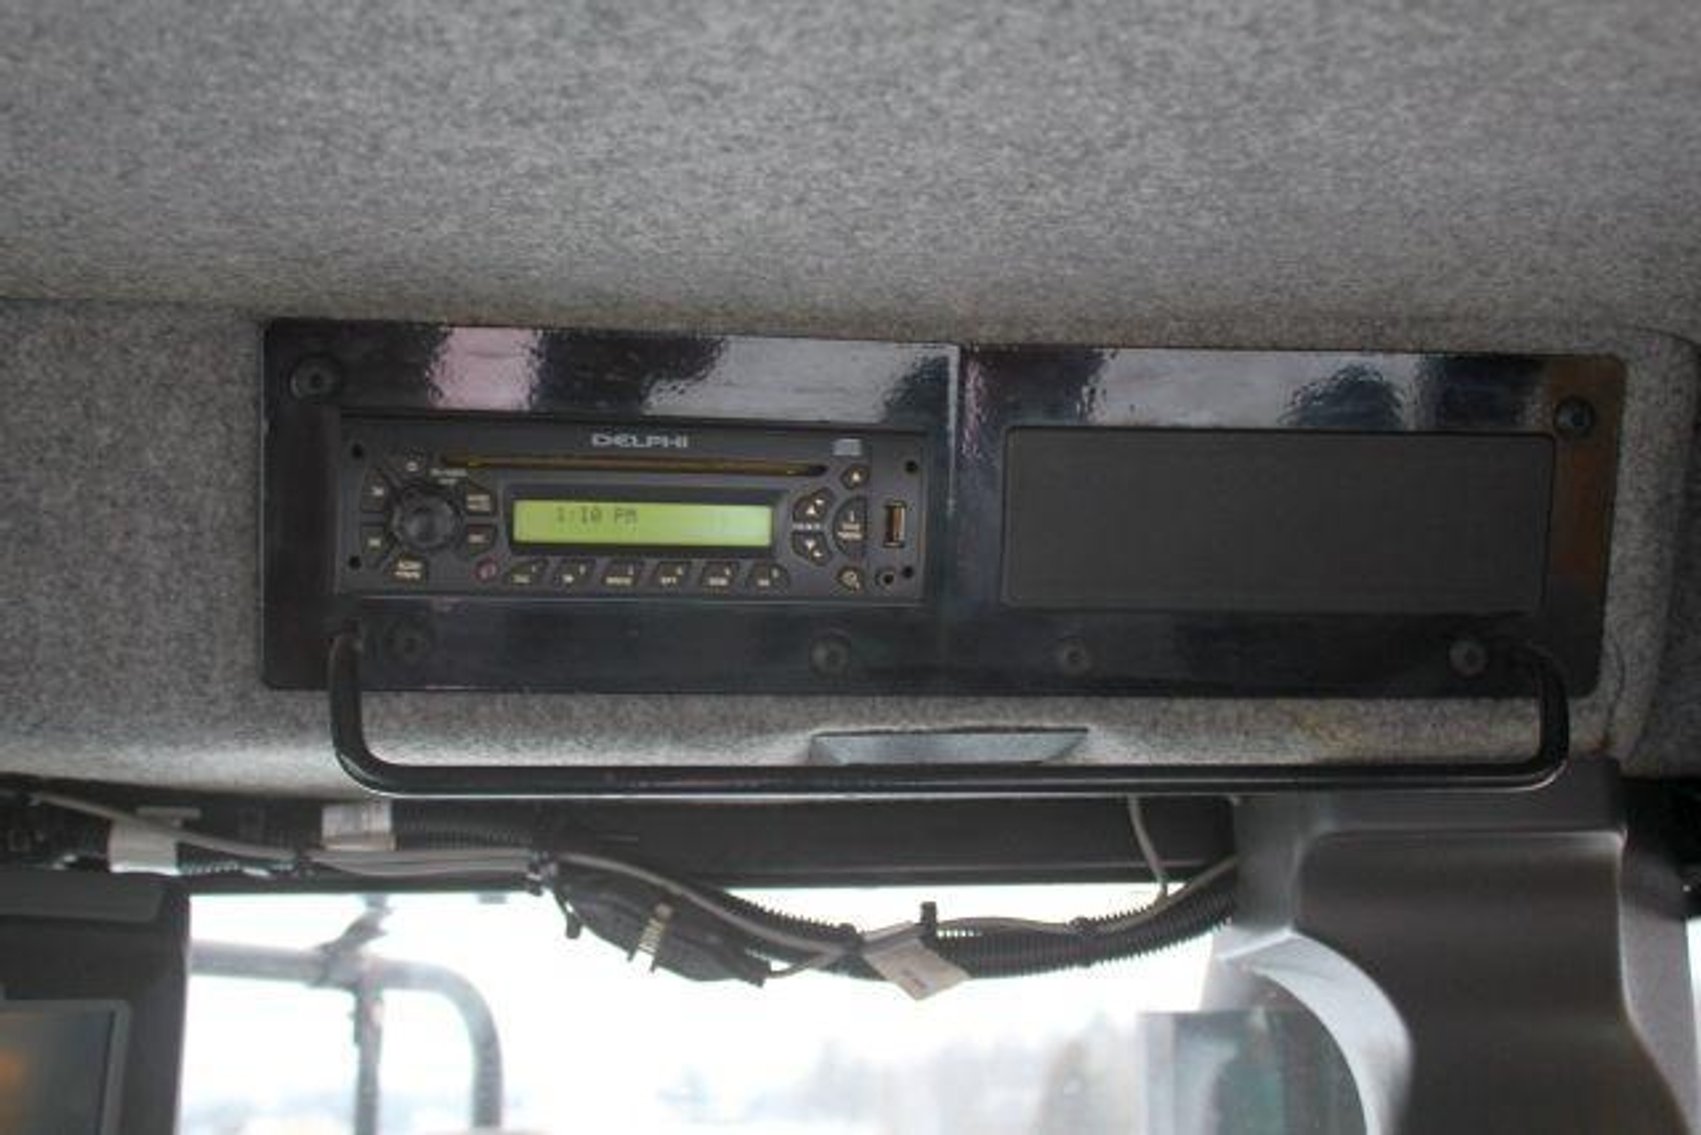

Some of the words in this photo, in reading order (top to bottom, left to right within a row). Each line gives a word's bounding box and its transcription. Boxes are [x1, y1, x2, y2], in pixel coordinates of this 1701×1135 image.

[591, 433, 689, 449] DELPHI
[555, 506, 603, 525] 1:10
[613, 507, 638, 525] PM
